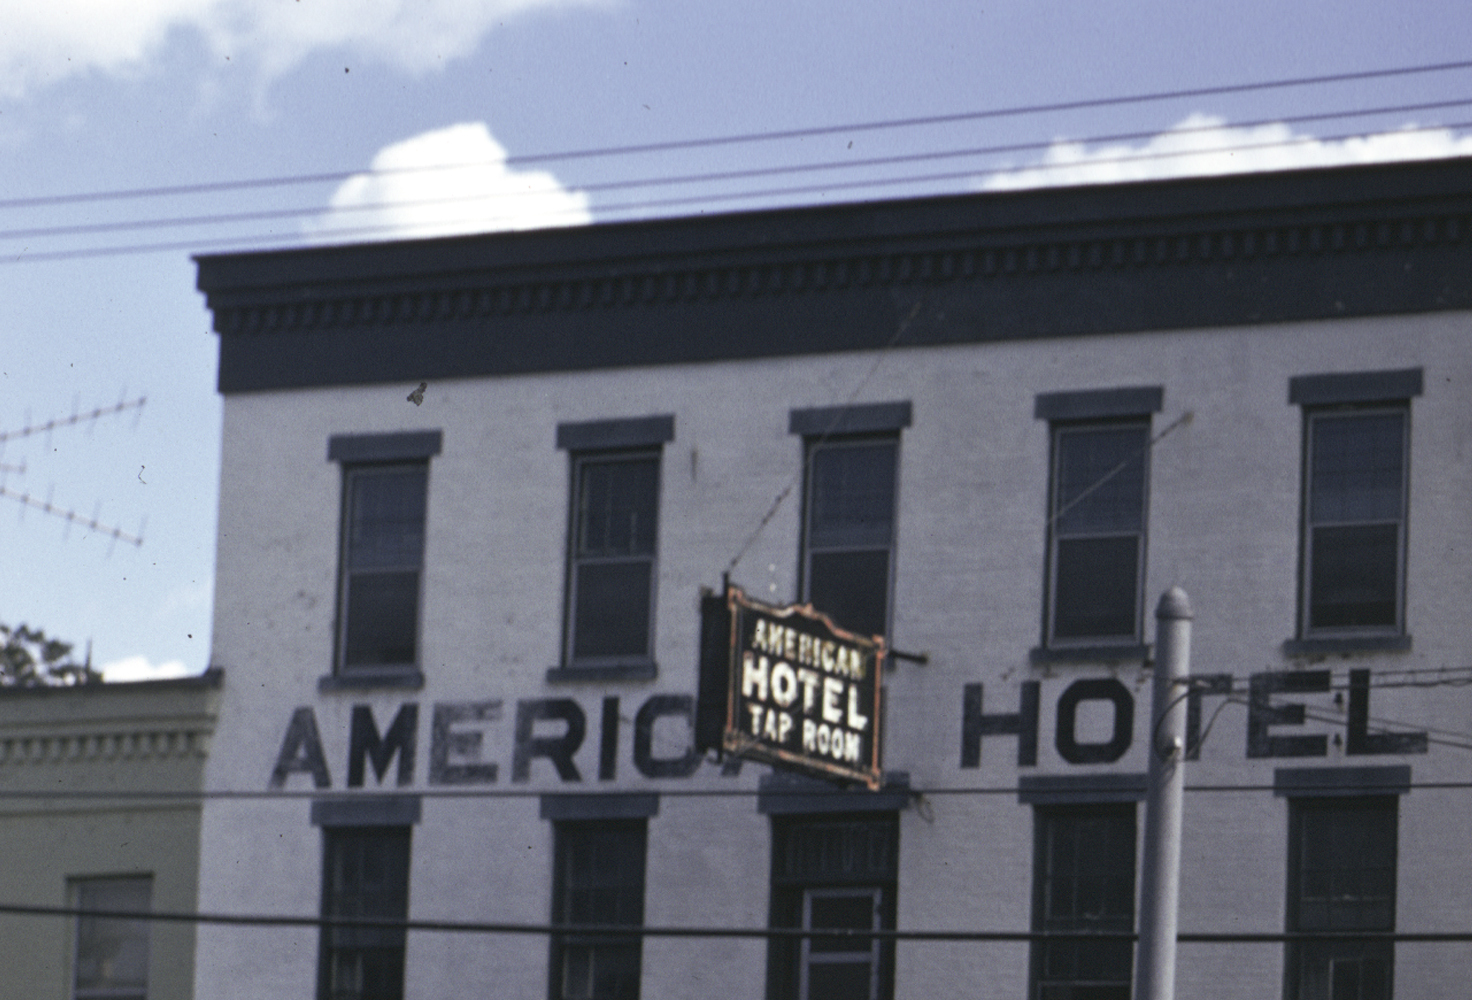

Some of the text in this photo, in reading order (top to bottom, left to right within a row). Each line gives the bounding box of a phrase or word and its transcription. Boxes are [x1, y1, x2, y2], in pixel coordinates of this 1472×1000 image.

[752, 618, 866, 680] AMERICAN
[741, 651, 868, 731] HOTEL
[268, 694, 745, 789] AMERIC
[748, 702, 861, 762] TAP ROOM
